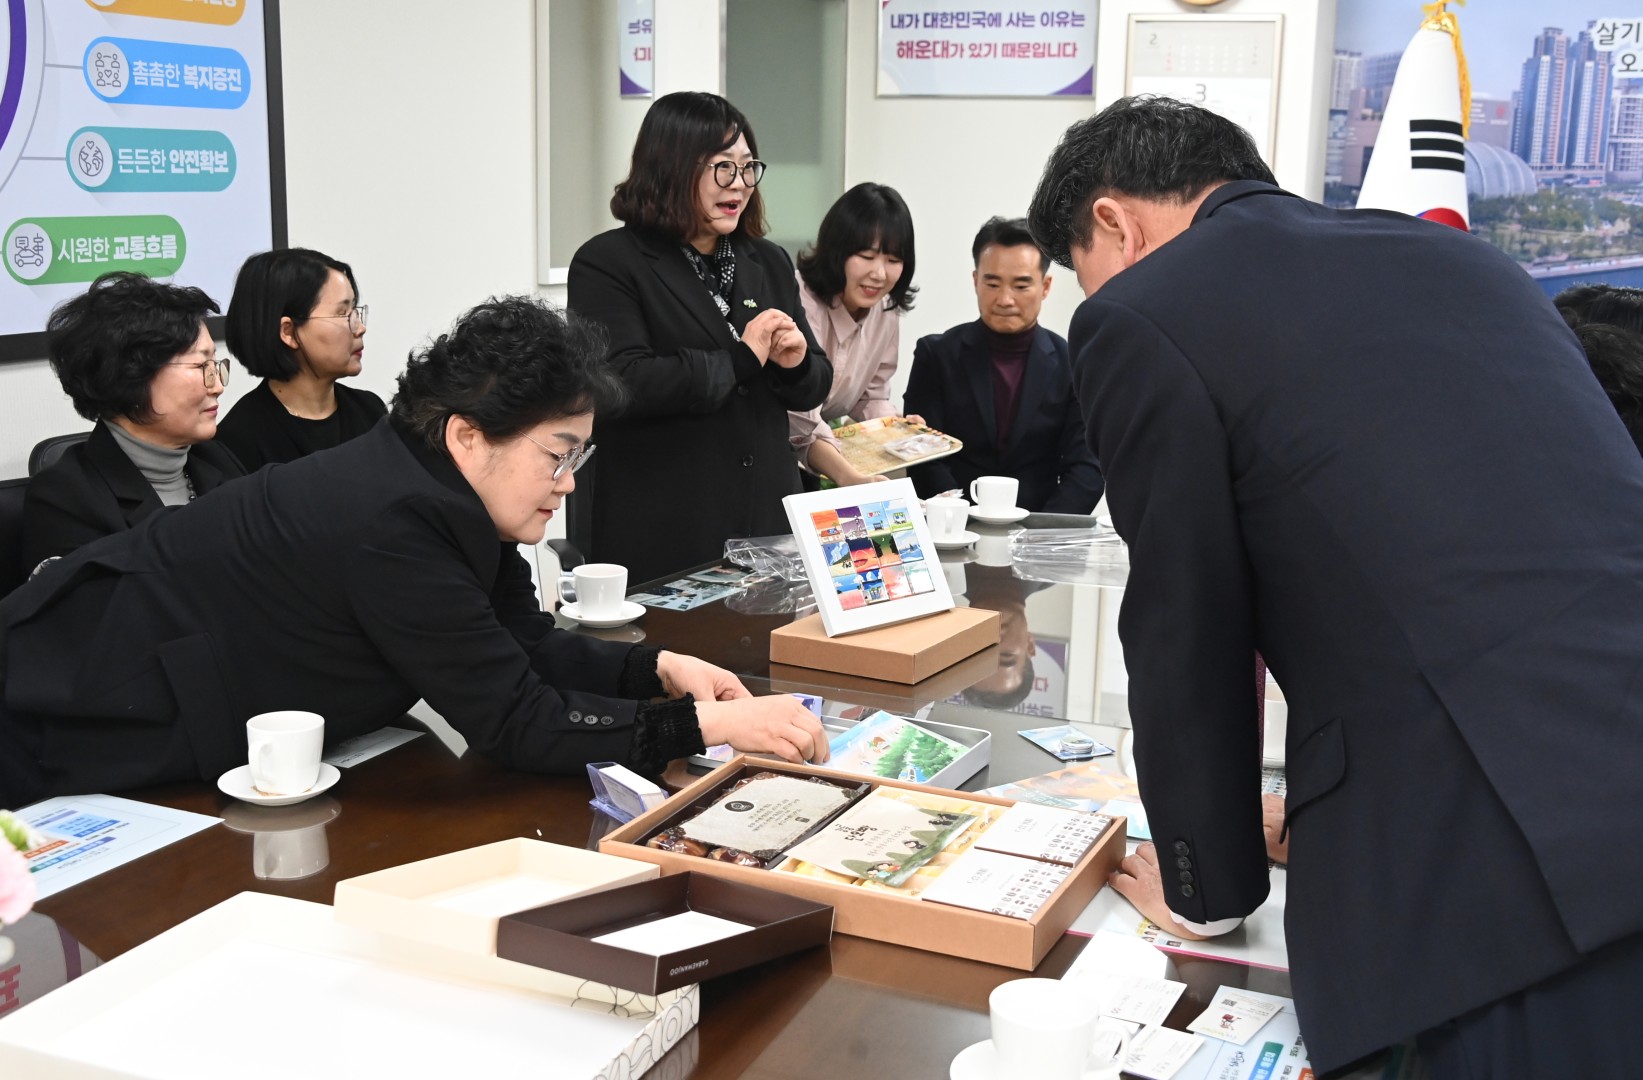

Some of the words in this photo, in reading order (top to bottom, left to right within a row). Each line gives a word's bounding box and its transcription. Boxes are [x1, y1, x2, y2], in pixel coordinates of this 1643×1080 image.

[890, 13, 919, 29] 내가
[923, 11, 1002, 29] 대한민국에
[1006, 11, 1035, 28] 사는
[1040, 11, 1085, 28] 이유는
[1597, 22, 1640, 45] 살기
[896, 40, 964, 59] 해운대가
[968, 42, 997, 59] 있기
[1001, 42, 1078, 59] 때문입니다
[1617, 53, 1643, 72] 오
[132, 60, 181, 88] 촘촘한
[183, 65, 242, 92] 복지증진
[1195, 83, 1207, 103] 3
[117, 148, 167, 174] 든든한
[169, 149, 229, 174] 안전확보
[57, 237, 110, 263] 시원한
[113, 235, 178, 260] 교통흐름
